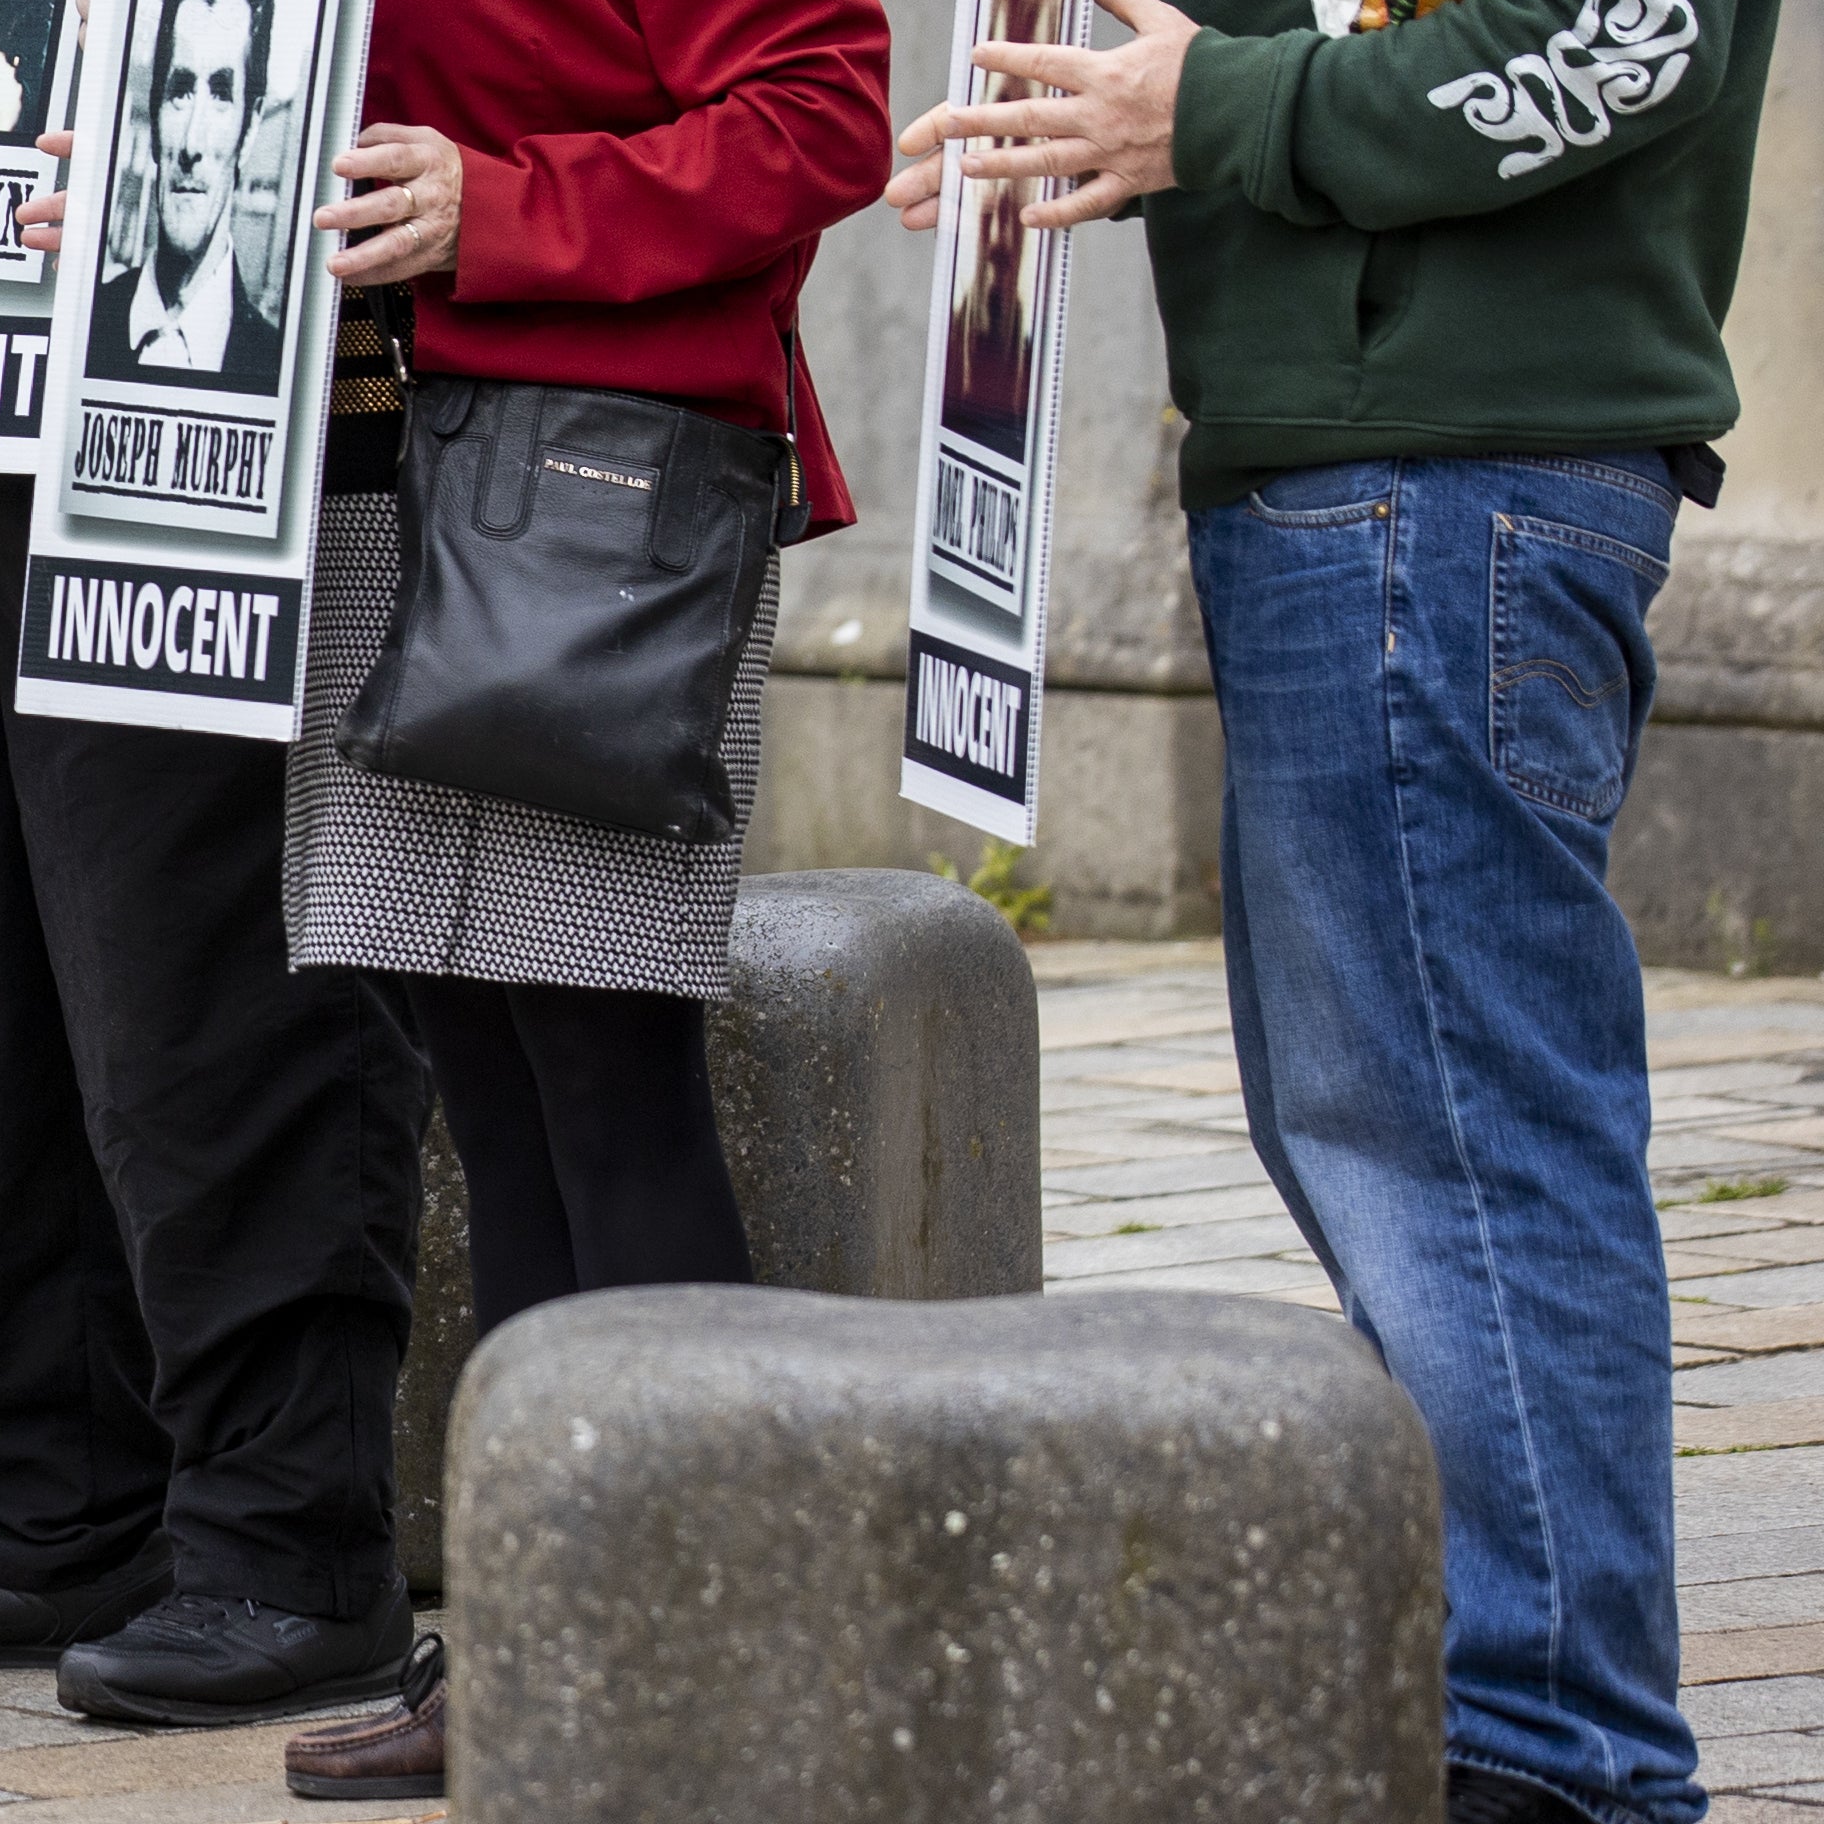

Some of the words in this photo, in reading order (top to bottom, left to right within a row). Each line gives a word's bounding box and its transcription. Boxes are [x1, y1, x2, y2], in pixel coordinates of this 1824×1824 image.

[74, 411, 164, 487] JOSEPH
[171, 422, 274, 500] MURPHY
[544, 458, 578, 475] PAUL
[49, 576, 278, 681] INNOCENT
[915, 652, 1022, 778] INNOCENT
